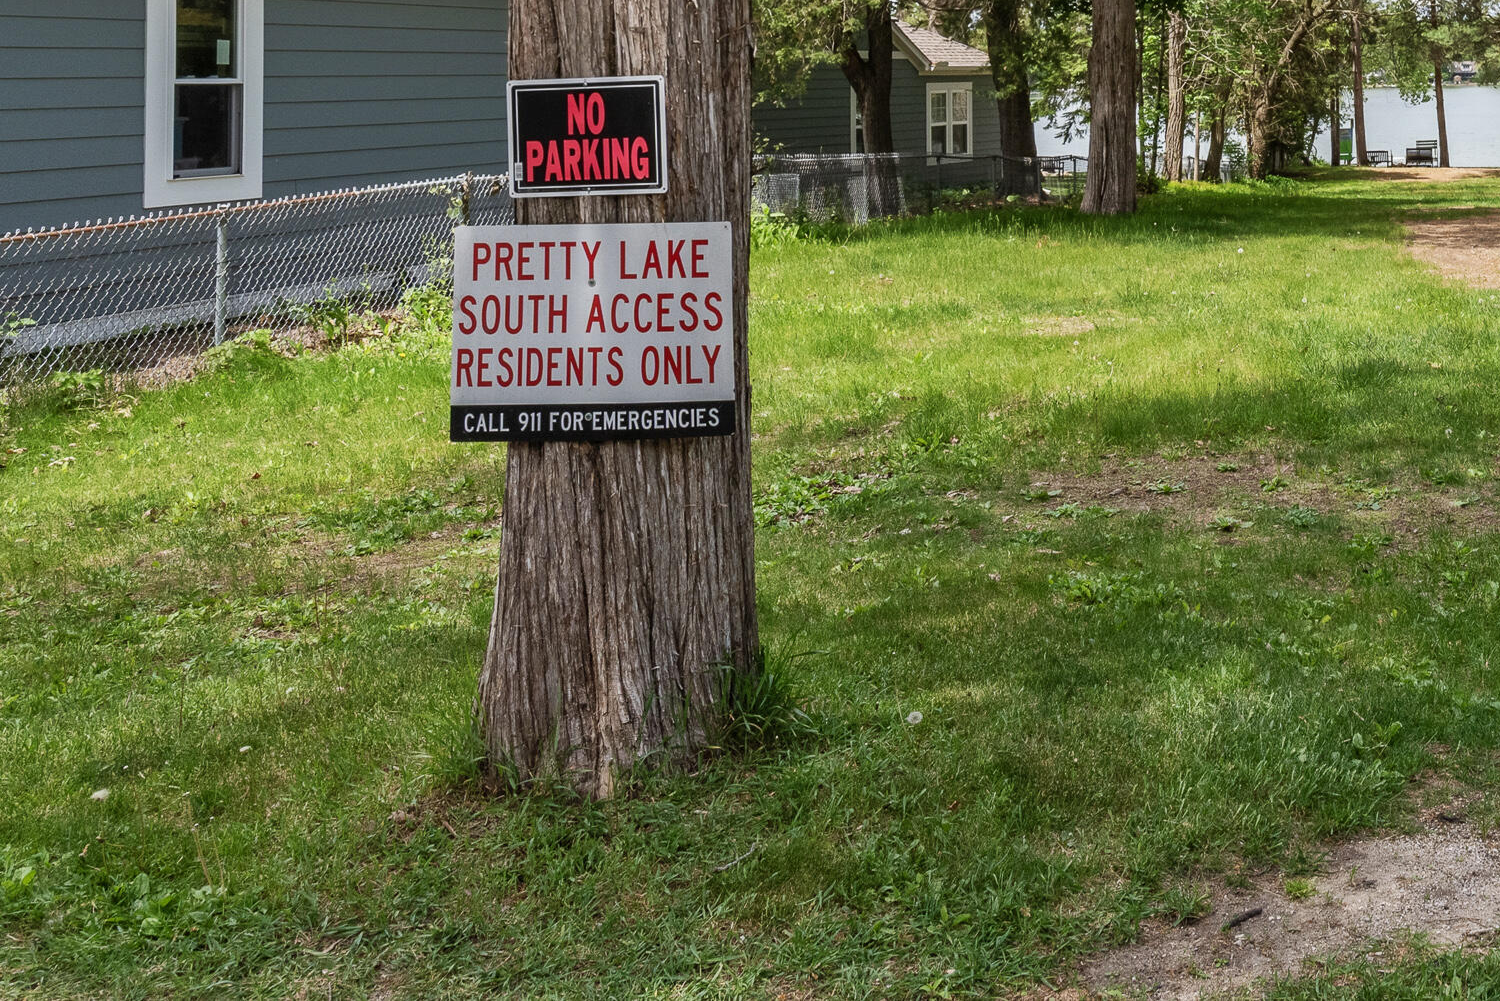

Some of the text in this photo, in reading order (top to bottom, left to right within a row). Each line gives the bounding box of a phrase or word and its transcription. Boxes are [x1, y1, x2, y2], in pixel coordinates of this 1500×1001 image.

[567, 92, 606, 135] NO
[525, 136, 650, 183] PARKING
[472, 239, 709, 281] PRETTY LAKE
[458, 292, 723, 335] SOUTH ACCESS
[456, 344, 722, 388] RESIDENTS ONLY
[463, 408, 720, 433] CALL 911 FOR EMERGENCIES
